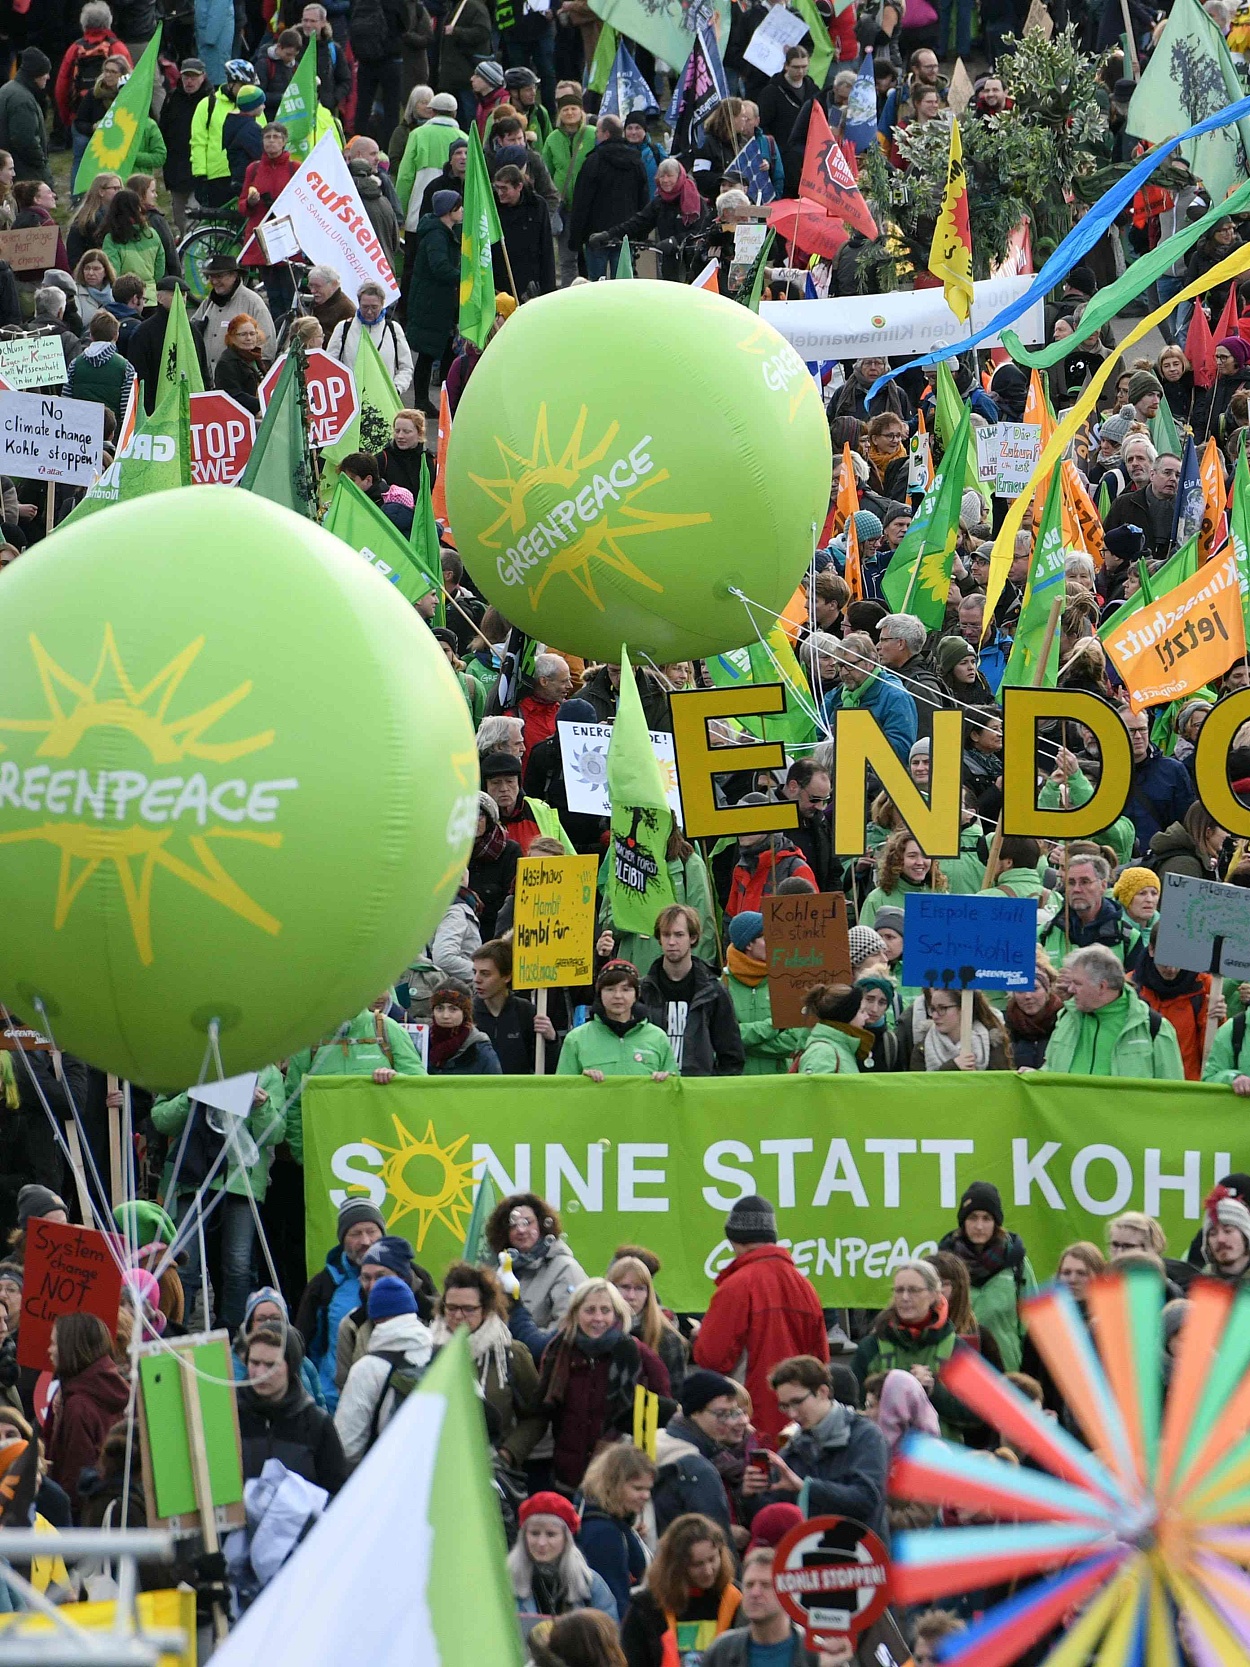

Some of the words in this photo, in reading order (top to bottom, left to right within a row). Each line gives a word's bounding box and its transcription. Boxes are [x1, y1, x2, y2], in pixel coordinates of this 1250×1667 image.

[306, 171, 400, 291] aufstehen
[41, 400, 63, 421] No
[4, 415, 50, 437] climate
[54, 425, 92, 454] change
[190, 419, 246, 461] TOP
[1013, 426, 1031, 441] Die
[5, 438, 40, 457] Kohle
[48, 446, 98, 472] stoppen!
[46, 467, 64, 477] attac
[996, 472, 1030, 493] Erneu
[495, 434, 655, 587] GREENPEACE
[573, 725, 668, 745] ENERGDE!
[667, 682, 1133, 859] END
[0, 760, 299, 825] REENPEACE
[522, 861, 564, 887] Haselmaus
[771, 901, 819, 922] Kohle
[518, 918, 551, 948] Hambi
[975, 969, 1024, 979] GREENPEACE
[701, 1138, 974, 1212] STATT
[34, 1225, 105, 1262] System
[50, 1253, 99, 1280] change
[40, 1271, 94, 1306] NOT
[774, 1571, 819, 1593] KOHLE
[820, 1565, 887, 1590] STOPPEN!
